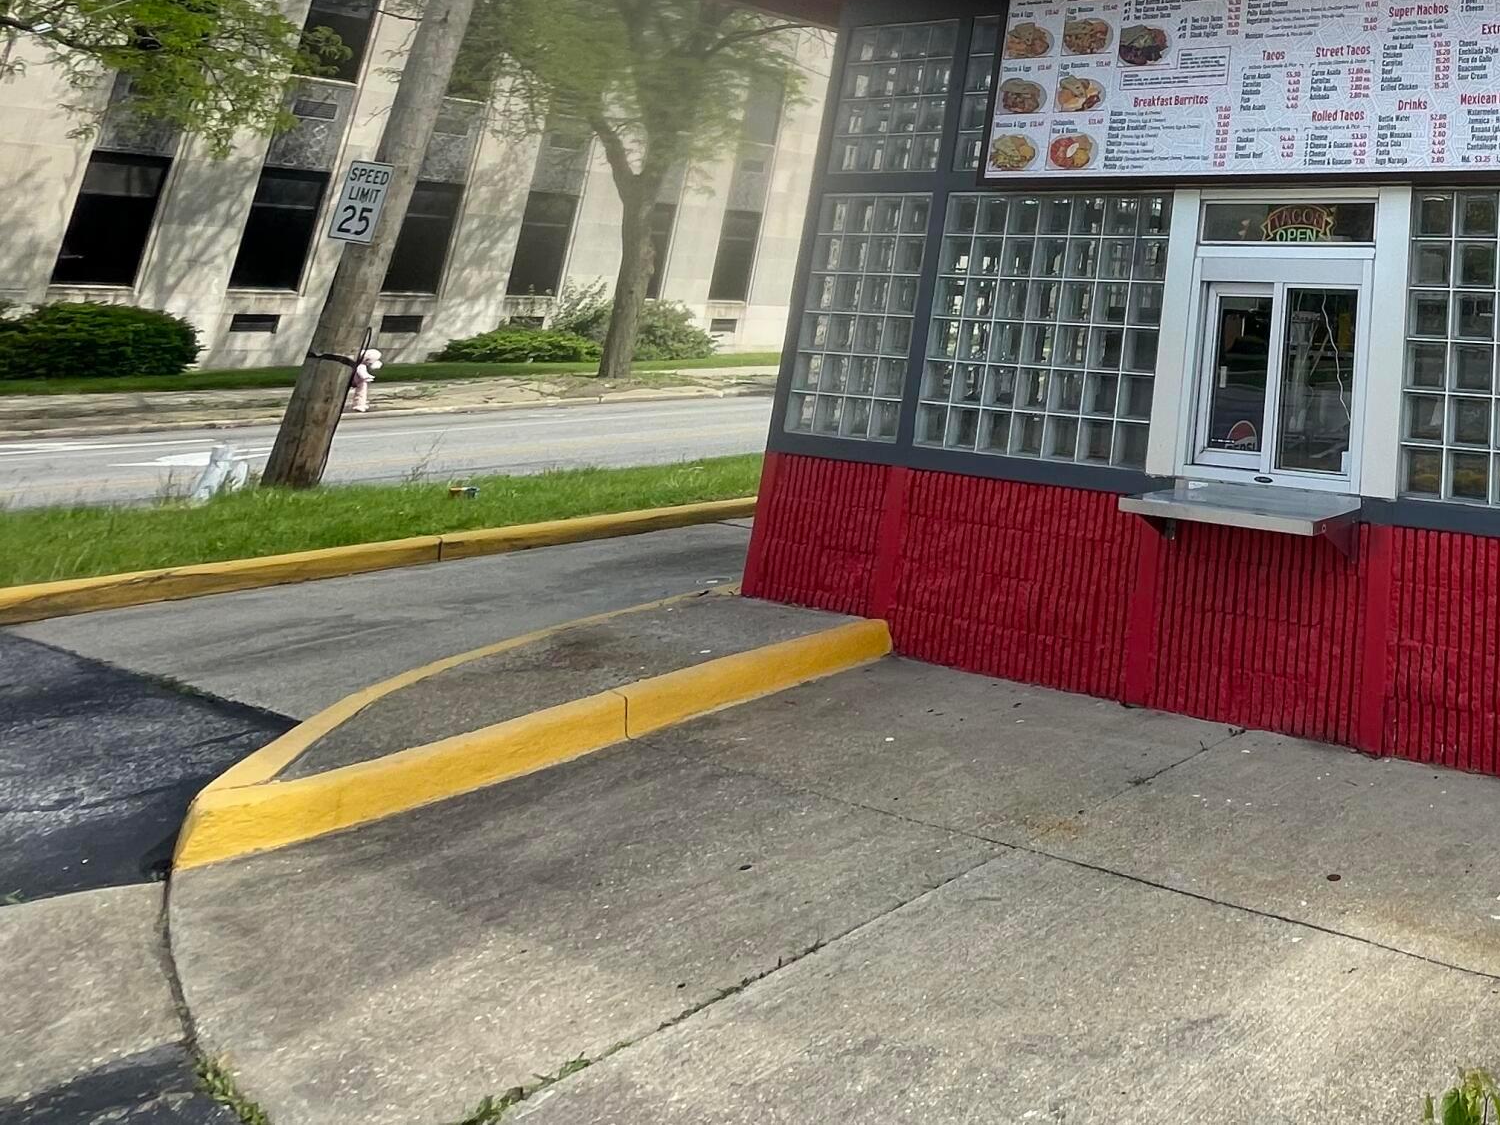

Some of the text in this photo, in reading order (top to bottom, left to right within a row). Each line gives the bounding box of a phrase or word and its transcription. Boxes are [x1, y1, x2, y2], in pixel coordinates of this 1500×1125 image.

[1389, 2, 1449, 19] Super Nachos
[1262, 50, 1285, 61] Tacos
[1315, 44, 1371, 58] Street Tacos
[1459, 47, 1484, 55] Enchilada
[1485, 46, 1499, 55] Style
[1458, 56, 1470, 64] Pico
[1479, 55, 1493, 63] Gallo
[1471, 72, 1488, 80] Cream
[1398, 82, 1418, 91] Chicken
[1133, 94, 1209, 108] Breakfast Burritos
[1398, 97, 1428, 111] Drinks
[1460, 93, 1497, 105] Mexican
[1312, 108, 1365, 123] Rolled Tacos
[1376, 139, 1402, 148] Coca Cola
[350, 167, 389, 185] SPEED
[349, 186, 381, 203] LIMIT
[337, 205, 373, 235] 25
[1270, 208, 1325, 228] TACOS
[1276, 229, 1316, 242] OPEN
